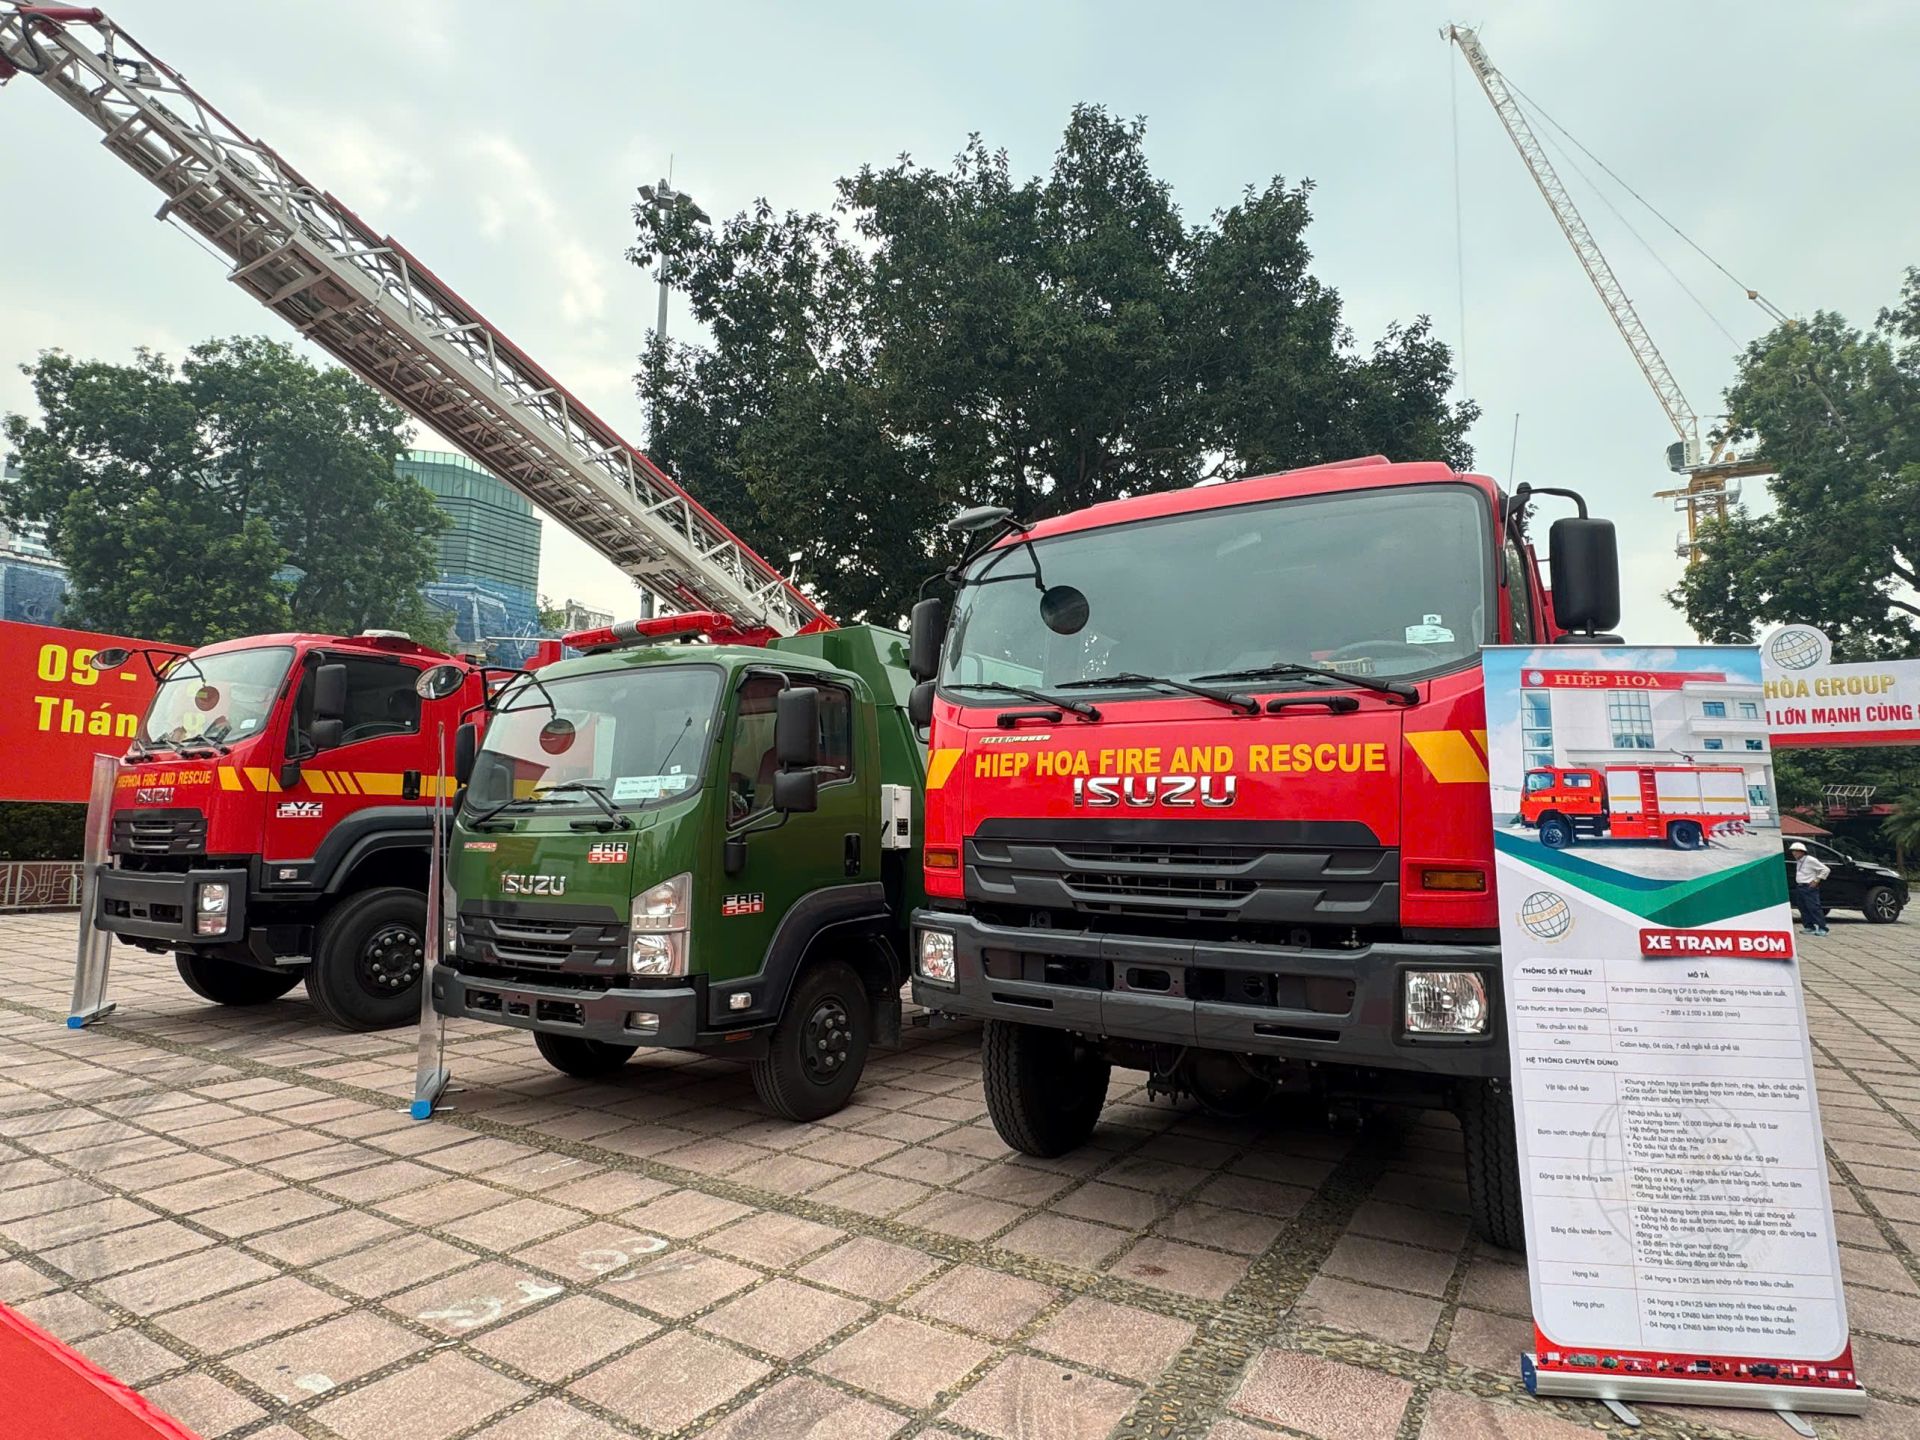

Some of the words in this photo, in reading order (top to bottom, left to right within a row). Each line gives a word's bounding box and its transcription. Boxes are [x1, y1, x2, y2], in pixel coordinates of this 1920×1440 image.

[1554, 671, 1608, 688] HIỆP
[1614, 672, 1662, 688] HOÀ
[1814, 673, 1896, 697] GROUP
[34, 695, 139, 738] Thán
[1775, 706, 1807, 726] LỚN
[1811, 706, 1862, 727] MẠNH
[1865, 702, 1914, 722] CÙNG
[974, 752, 1030, 778] HIEP
[1035, 750, 1090, 777] HOA
[1098, 747, 1161, 775] FIRE
[1169, 744, 1235, 774] AND
[1248, 742, 1386, 773] RESCUE
[142, 773, 158, 787] FIRE
[158, 771, 176, 786] AND
[178, 770, 212, 785] RESCUE
[1072, 775, 1238, 808] ISUZU
[277, 801, 322, 810] FVZ
[590, 842, 628, 852] FRR
[588, 852, 628, 863] 650
[501, 874, 567, 896] ISUZU
[723, 893, 764, 904] FRR
[722, 903, 764, 916] 650
[1646, 935, 1673, 951] XE
[1679, 936, 1734, 955] TRẠM
[1739, 936, 1787, 953] BƠM
[1547, 967, 1558, 975] SỐ
[1687, 971, 1699, 979] MÔ
[1618, 1025, 1633, 1033] Euro
[1526, 1056, 1536, 1064] HỆ
[1538, 1056, 1563, 1064] THỐNG
[1624, 1078, 1646, 1087] Khung
[1759, 1122, 1767, 1130] 10
[1634, 1150, 1649, 1158] Thời
[1650, 1152, 1664, 1160] gian
[1755, 1155, 1764, 1163] 50
[1650, 1167, 1683, 1176] HYUNDAI
[1683, 1243, 1698, 1251] gian
[1654, 1275, 1672, 1284] họng
[1678, 1276, 1701, 1285] DN125
[1744, 1279, 1759, 1287] theo
